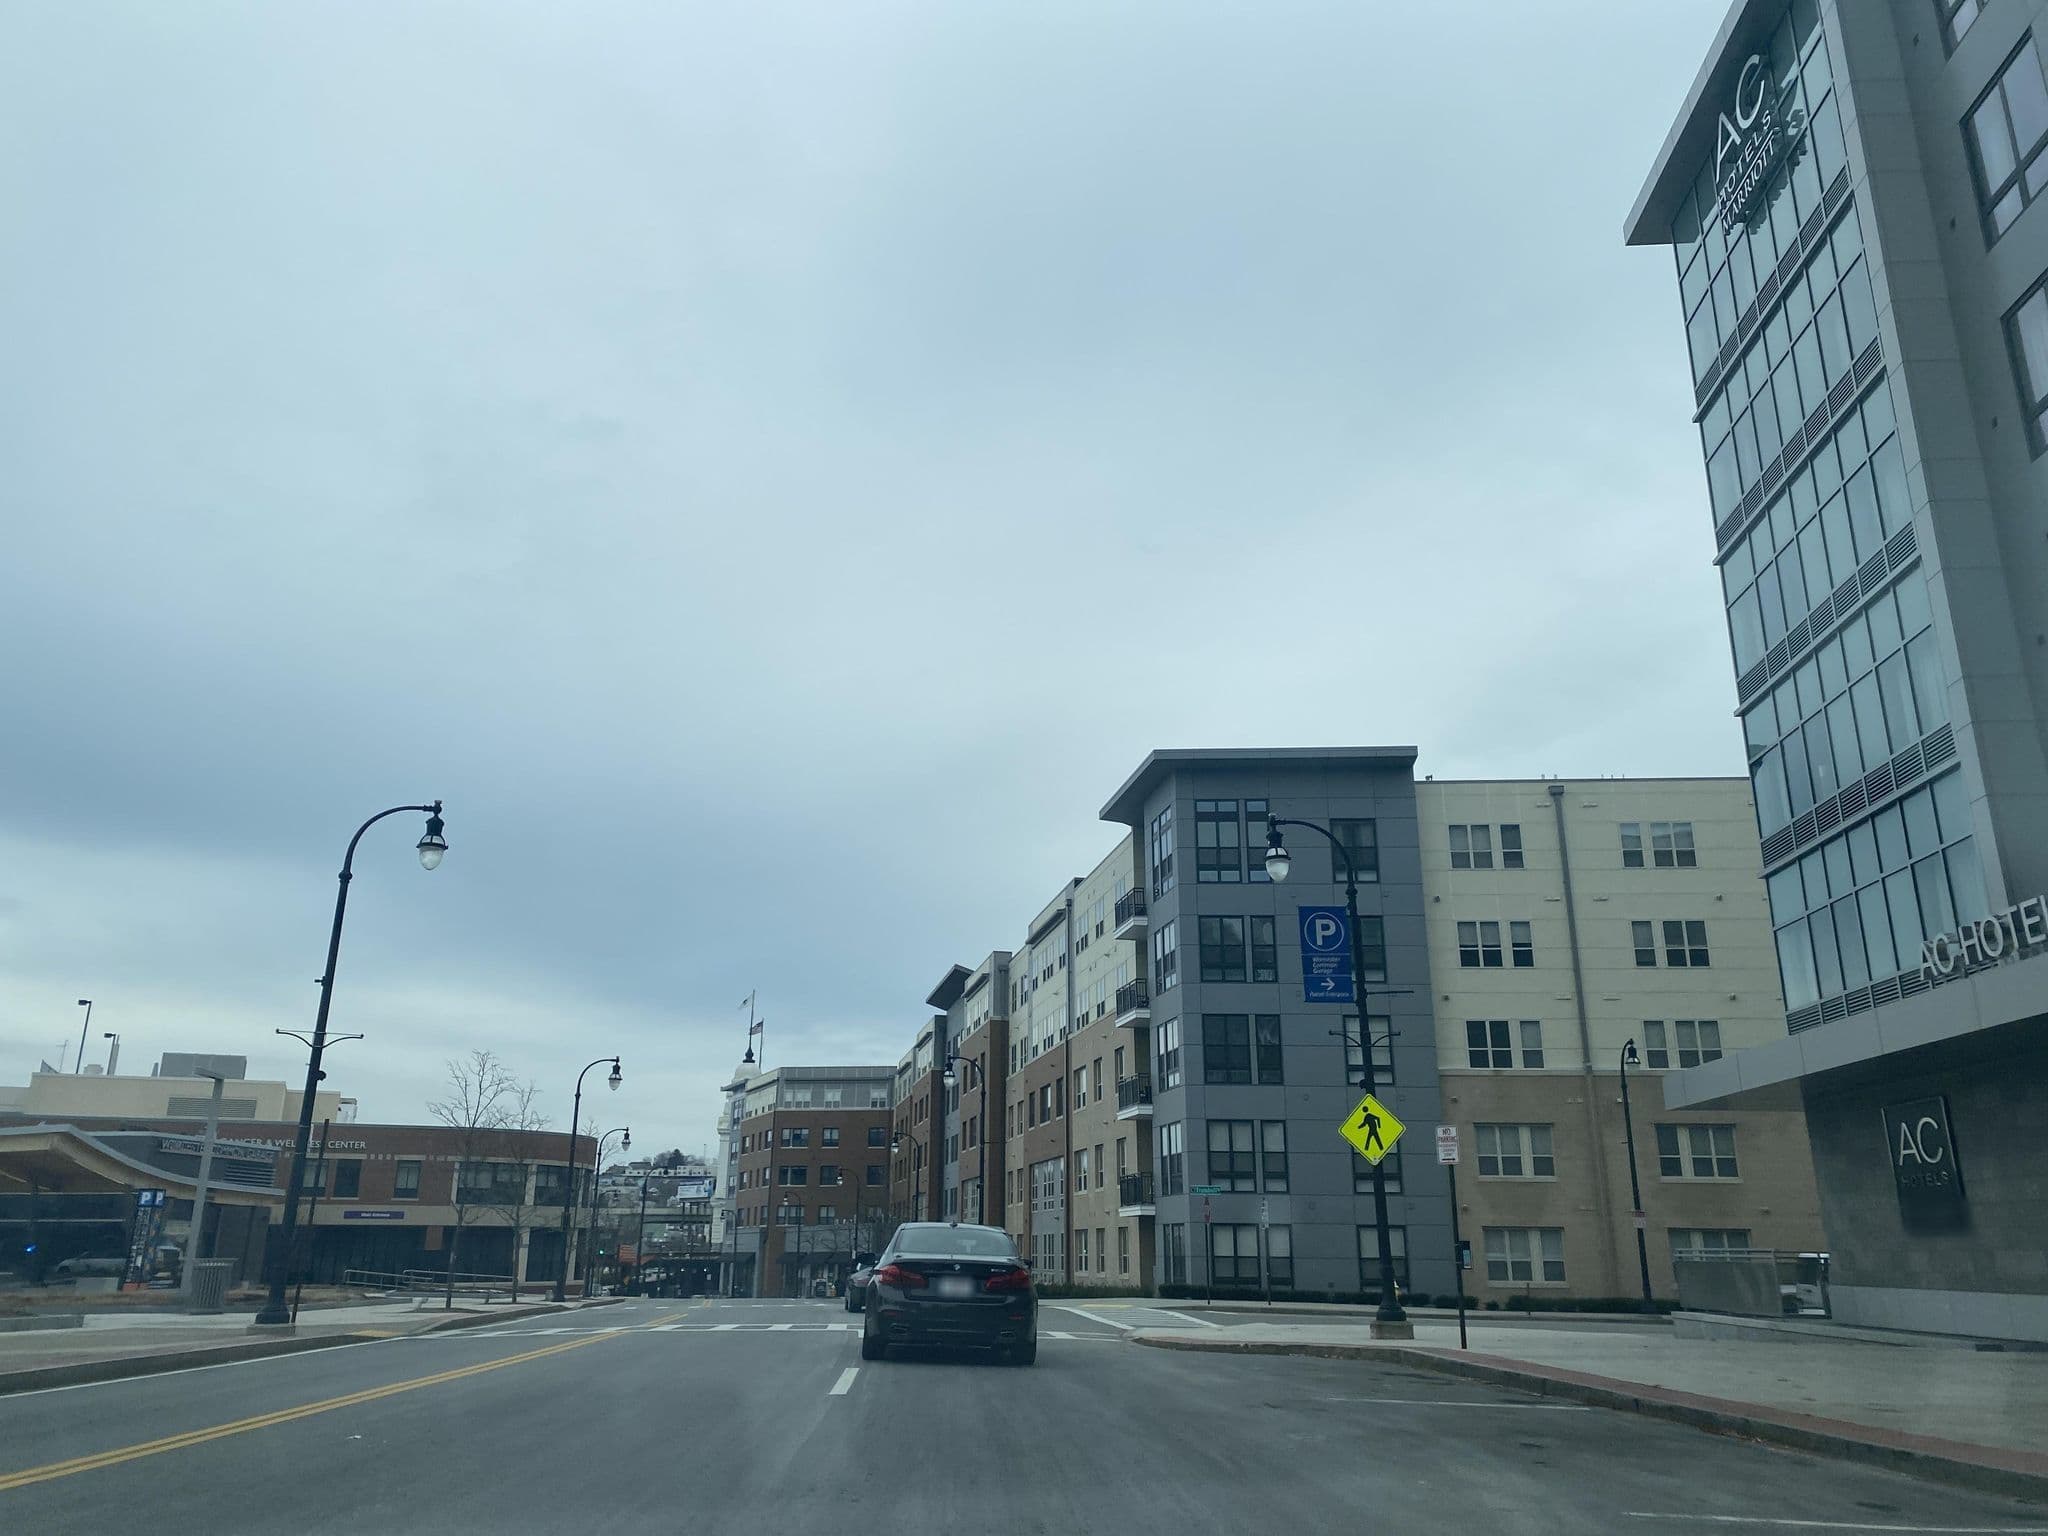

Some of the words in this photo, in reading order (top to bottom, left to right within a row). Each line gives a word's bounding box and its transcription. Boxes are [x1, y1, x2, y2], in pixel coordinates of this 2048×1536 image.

[1716, 54, 1765, 184] AC
[1717, 110, 1771, 210] HOTELS
[1721, 135, 1775, 236] MARRIOTT
[1315, 918, 1336, 946] P
[1920, 933, 1955, 981] AC
[328, 1140, 366, 1149] CENTER
[1899, 1117, 1944, 1167] AC
